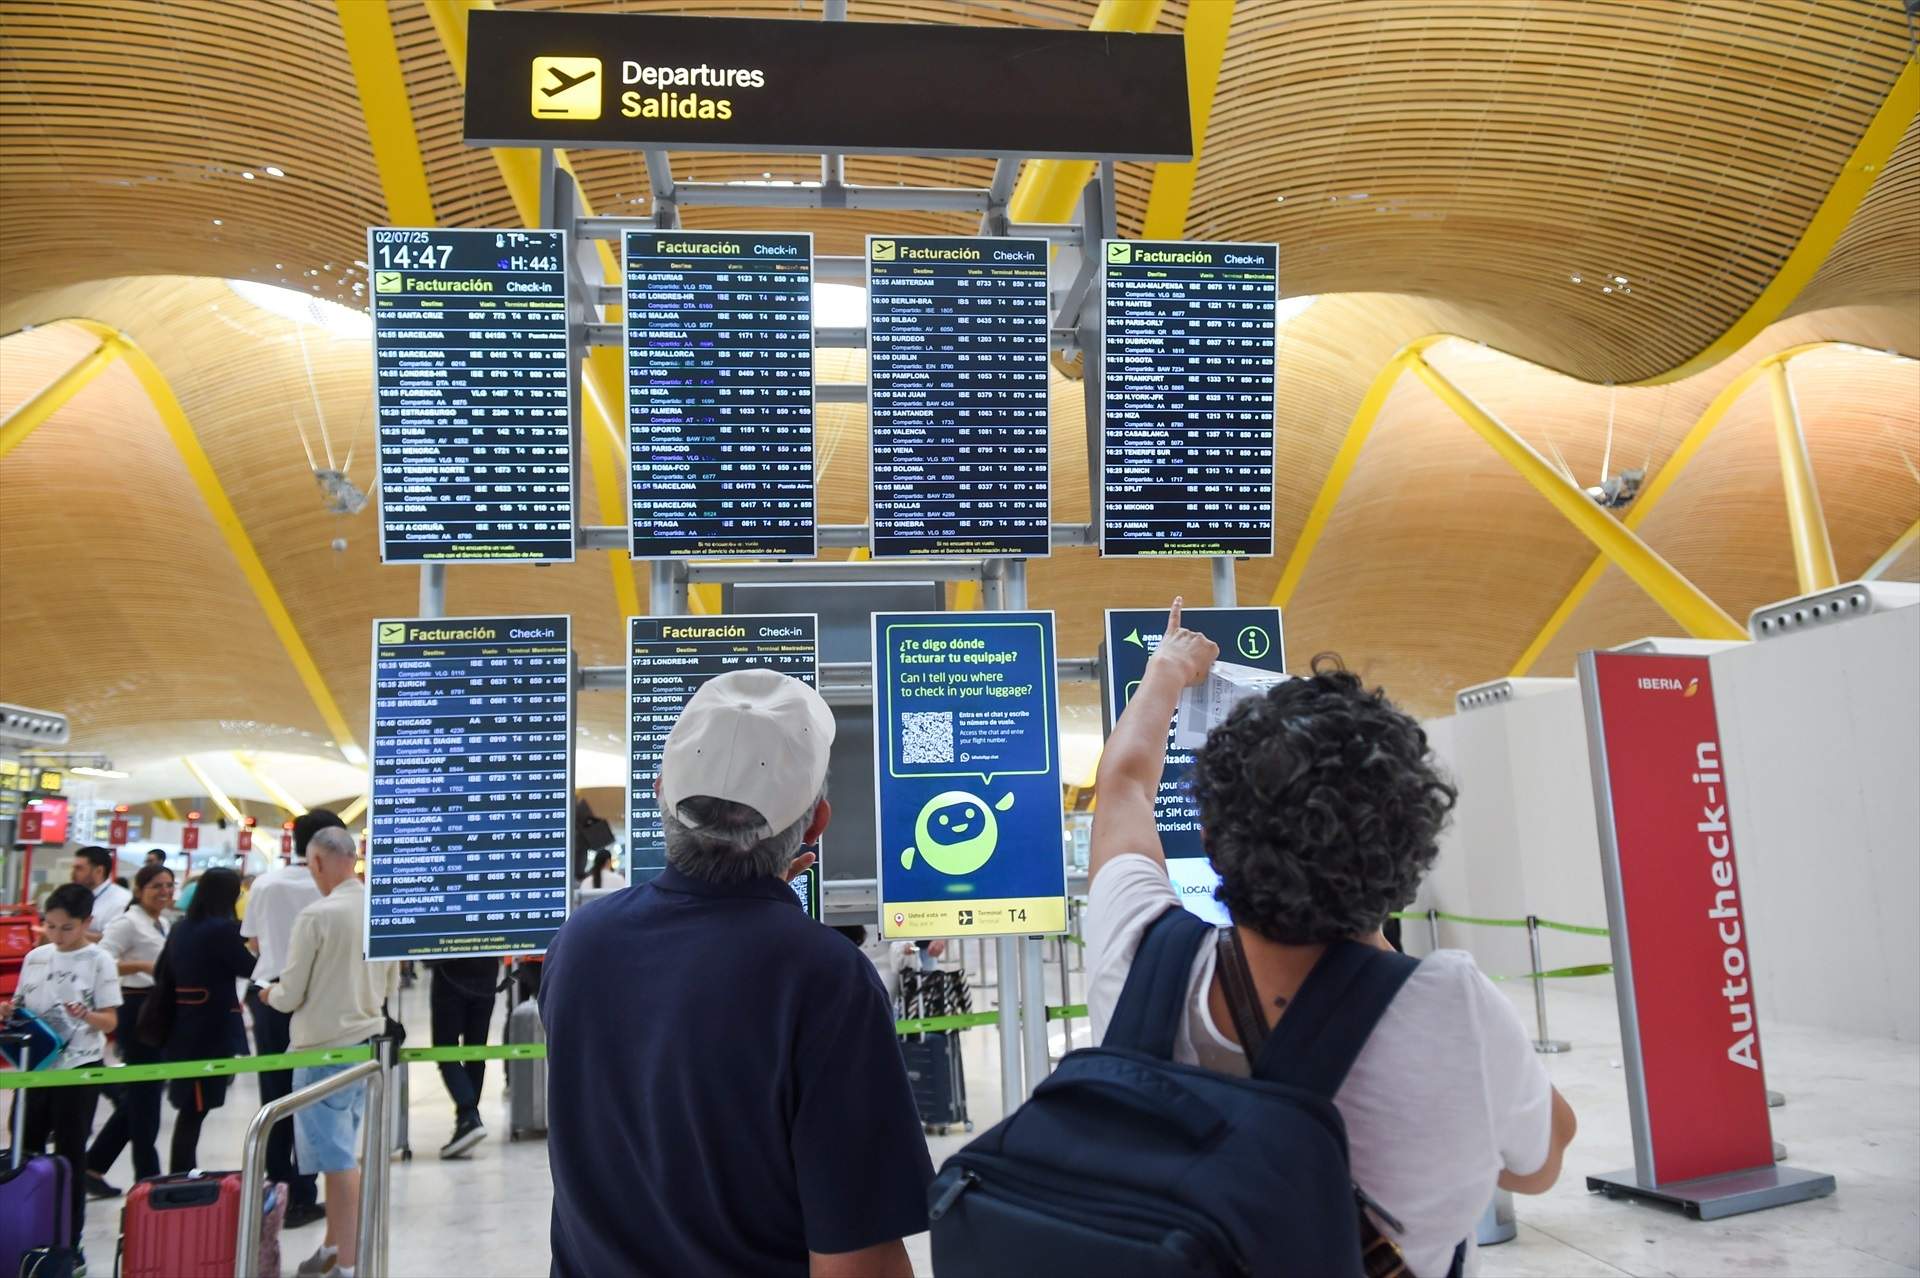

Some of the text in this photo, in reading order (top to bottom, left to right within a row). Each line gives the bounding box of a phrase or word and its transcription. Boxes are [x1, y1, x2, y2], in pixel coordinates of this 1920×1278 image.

[621, 60, 765, 91] Departures
[620, 91, 733, 120] Salidas
[375, 232, 430, 244] 02/07/25
[656, 241, 797, 255] Facturación Check-in
[900, 247, 1035, 261] Facturación Check-in
[378, 245, 454, 269] 14:47
[1135, 250, 1264, 264] Facturación Check-in
[406, 278, 552, 293] Facturación Check-in
[409, 628, 555, 641] Facturación Check-in
[663, 625, 802, 638] Facturación Check-in
[900, 638, 985, 652] ¿Te digo dónde
[900, 651, 1018, 665] facturar tu equipaje?
[900, 672, 920, 683] Can
[928, 671, 946, 683] tell
[948, 673, 968, 686] you
[970, 671, 1003, 682] where
[1637, 677, 1683, 692] IBERIA
[901, 684, 1032, 698] to check in your luggage?
[1159, 782, 1178, 792] your
[1166, 808, 1182, 817] SIM
[393, 856, 446, 864] MANCHESTER
[1182, 885, 1212, 895] LOCAL
[1692, 740, 1759, 1072] Autocheck-in
[1008, 909, 1027, 922] T4
